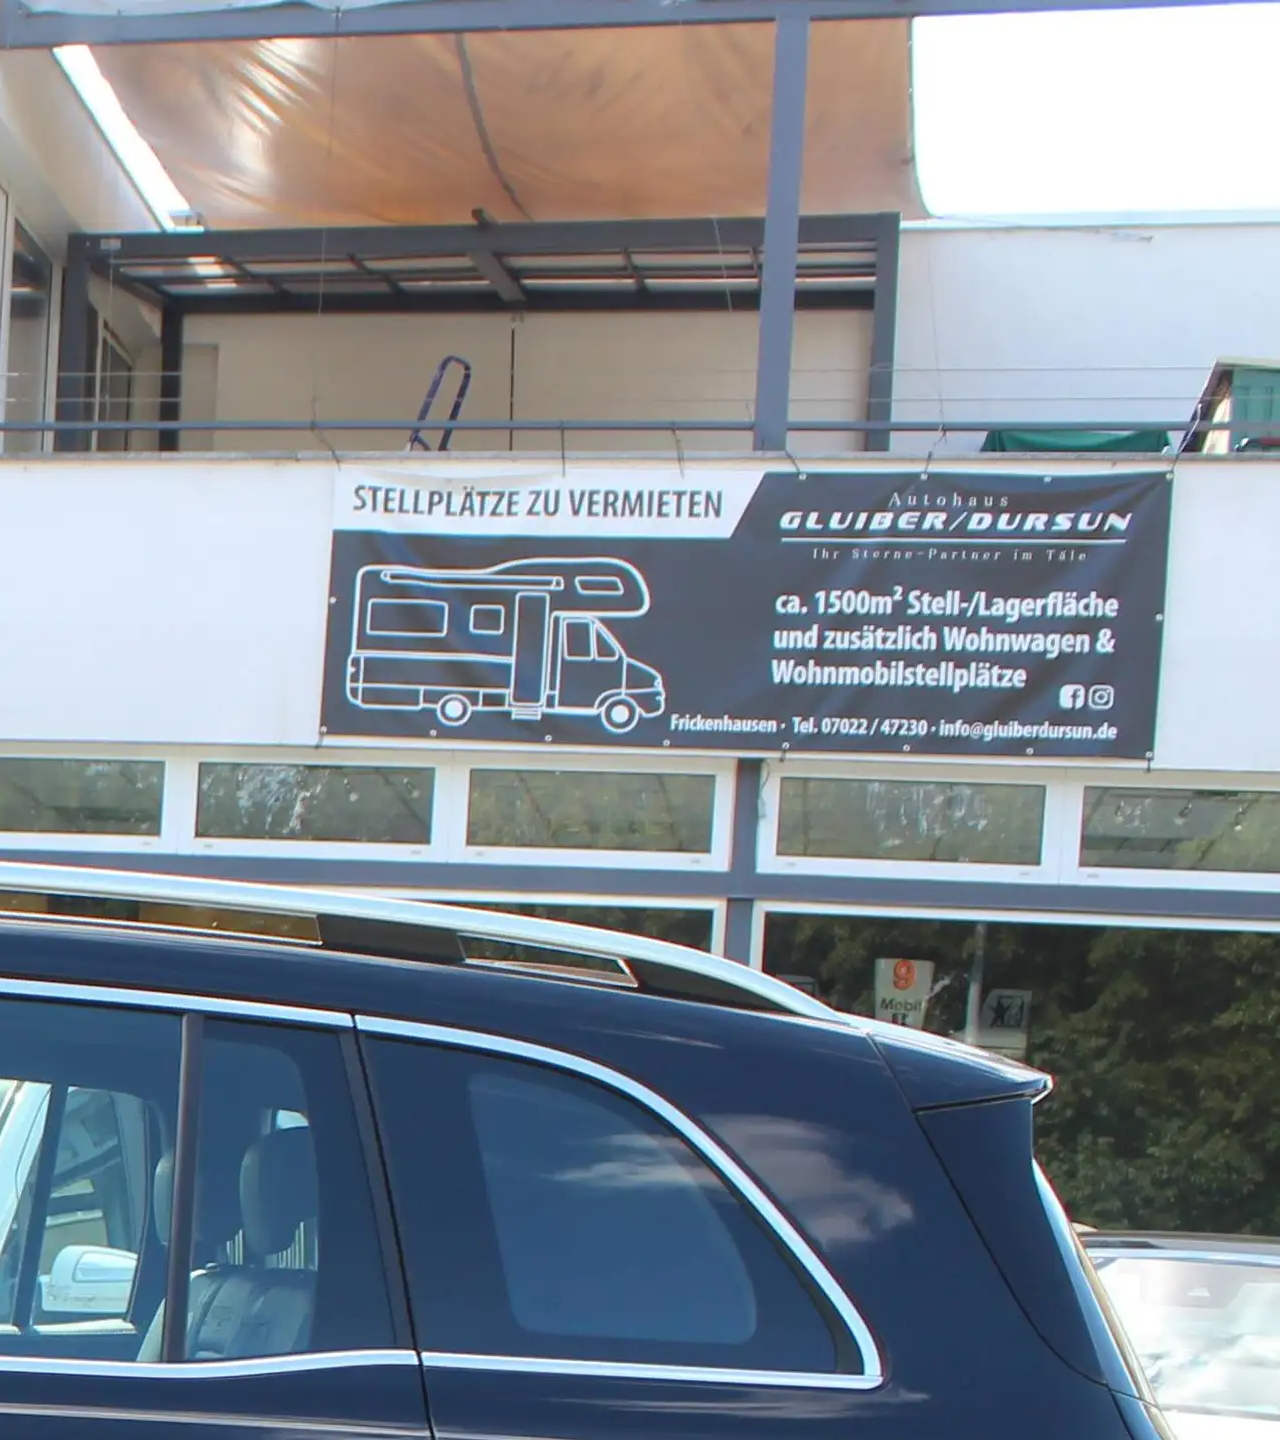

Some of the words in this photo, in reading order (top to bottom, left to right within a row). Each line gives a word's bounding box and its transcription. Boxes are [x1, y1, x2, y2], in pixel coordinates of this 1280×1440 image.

[353, 484, 520, 517] STELLPLÄTZE
[525, 489, 560, 518] ZU
[568, 489, 723, 519] VERMIETEN
[888, 492, 1010, 508] Autohaus
[779, 511, 1133, 533] GLUIBER/DURSUN
[812, 547, 840, 560] Ihr
[1013, 548, 1034, 561] im
[1046, 548, 1088, 562] Täle
[775, 593, 808, 615] ca.
[814, 586, 903, 615] 1500m²
[906, 589, 1119, 623] Stell-/Lagerfläche
[773, 624, 819, 650] und
[823, 625, 937, 652] zusätzlich
[943, 625, 1091, 659] Wohnwagen
[1095, 628, 1117, 653] &
[771, 659, 1027, 694] Wohnmobilstellplätze
[670, 714, 778, 733] Frickenhausen
[792, 716, 819, 734] Tel.
[821, 717, 867, 734] 07022
[881, 719, 927, 735] 47230
[939, 719, 1118, 741] info@gluiberdursun.de
